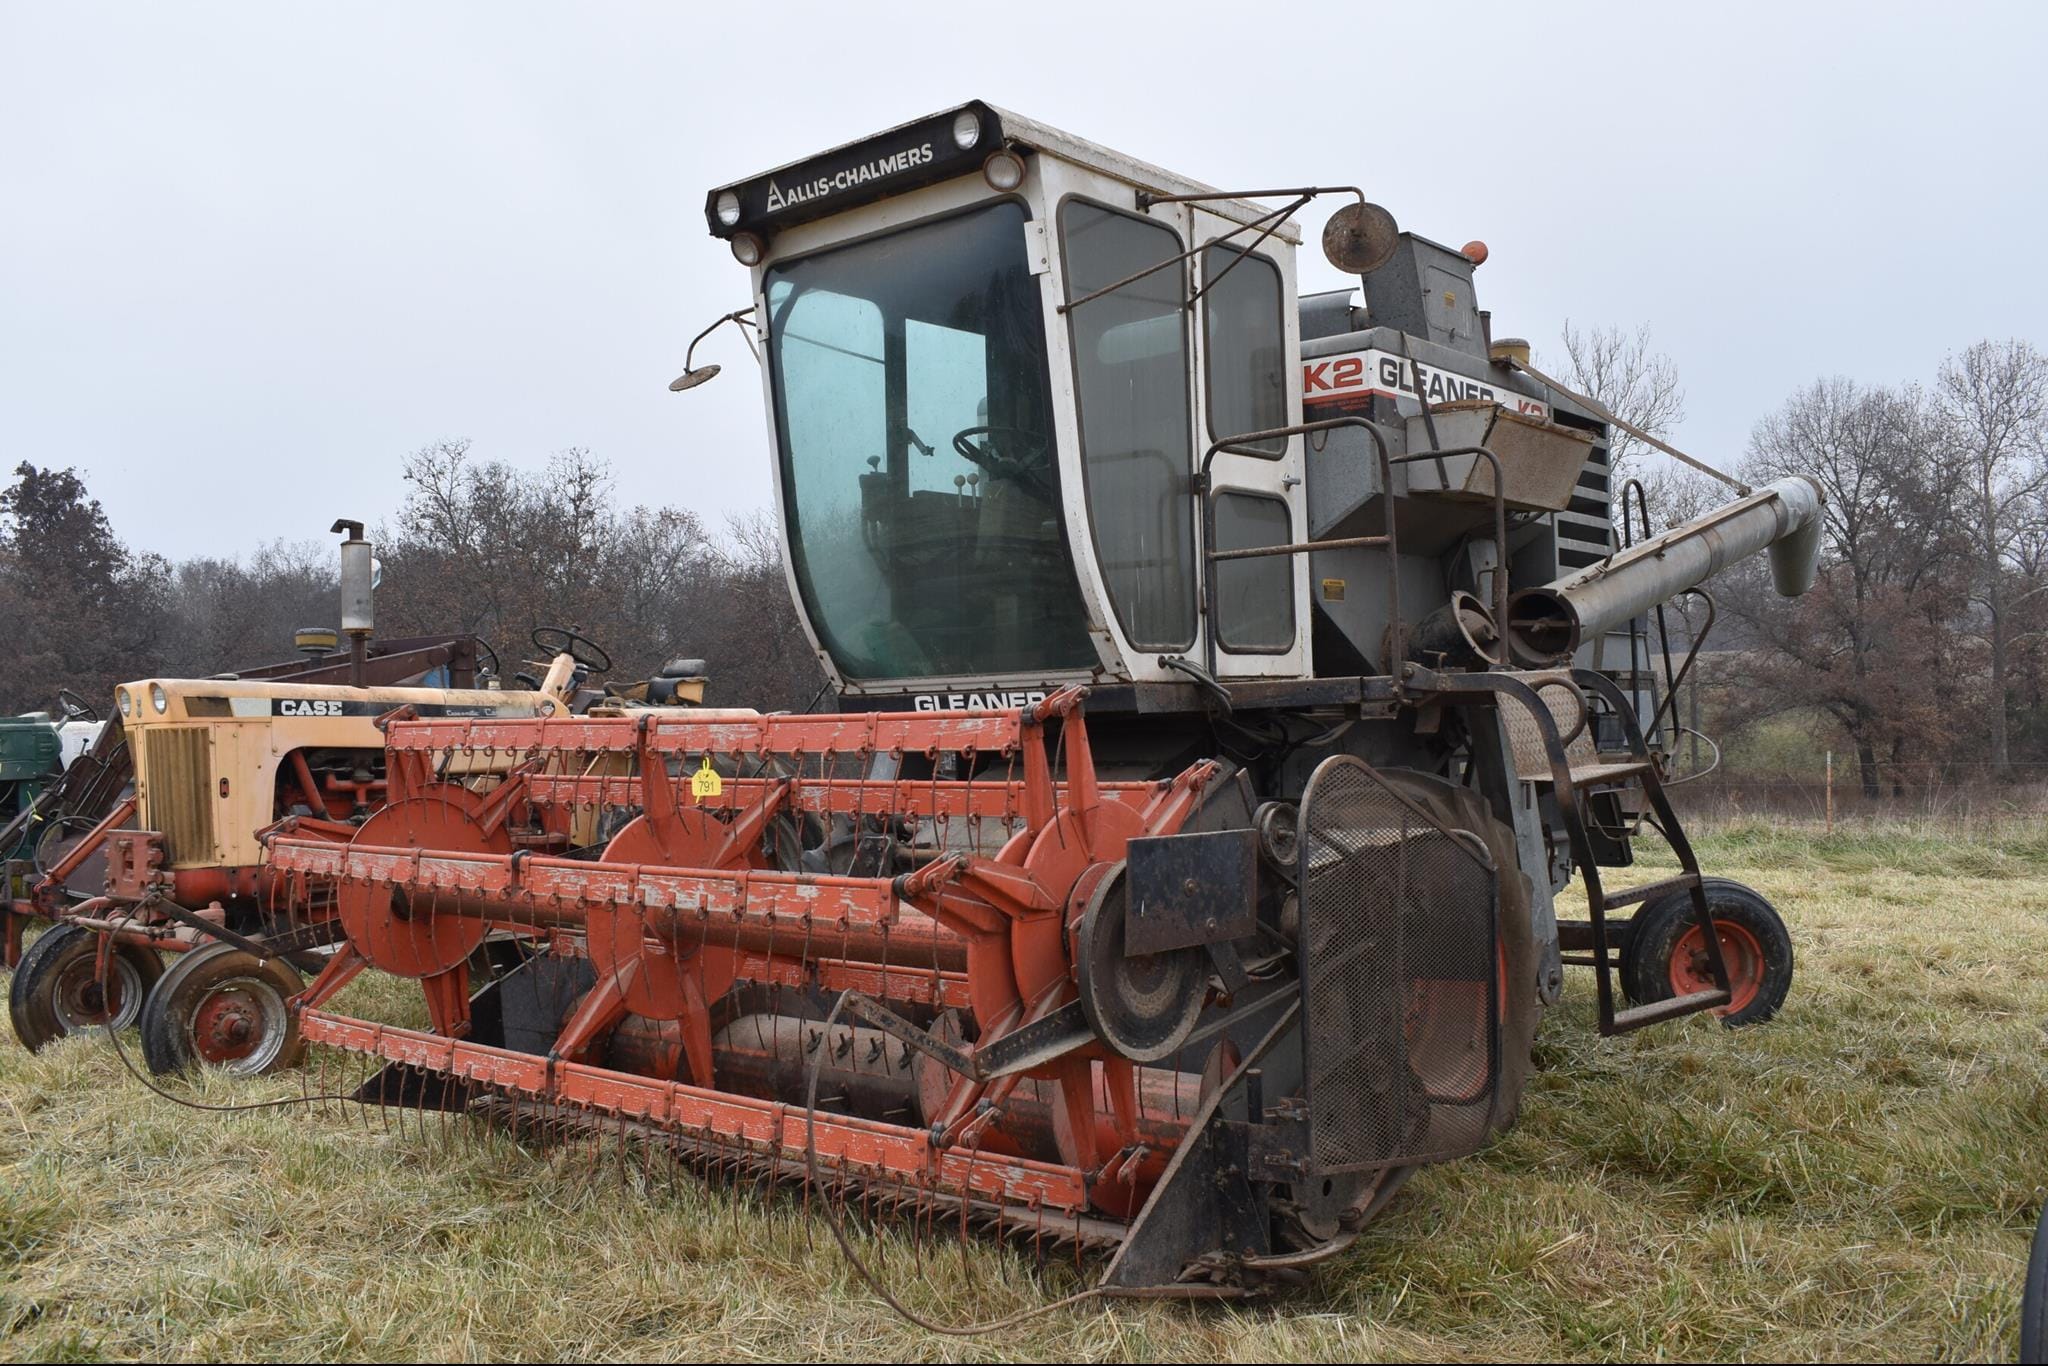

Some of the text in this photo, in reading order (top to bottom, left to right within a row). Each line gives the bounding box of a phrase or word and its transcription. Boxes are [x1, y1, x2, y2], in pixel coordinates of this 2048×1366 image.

[787, 143, 933, 206] ALLIS-CHALMERS
[1304, 357, 1363, 393] K2
[280, 700, 343, 716] CASE
[698, 780, 714, 793] 791
